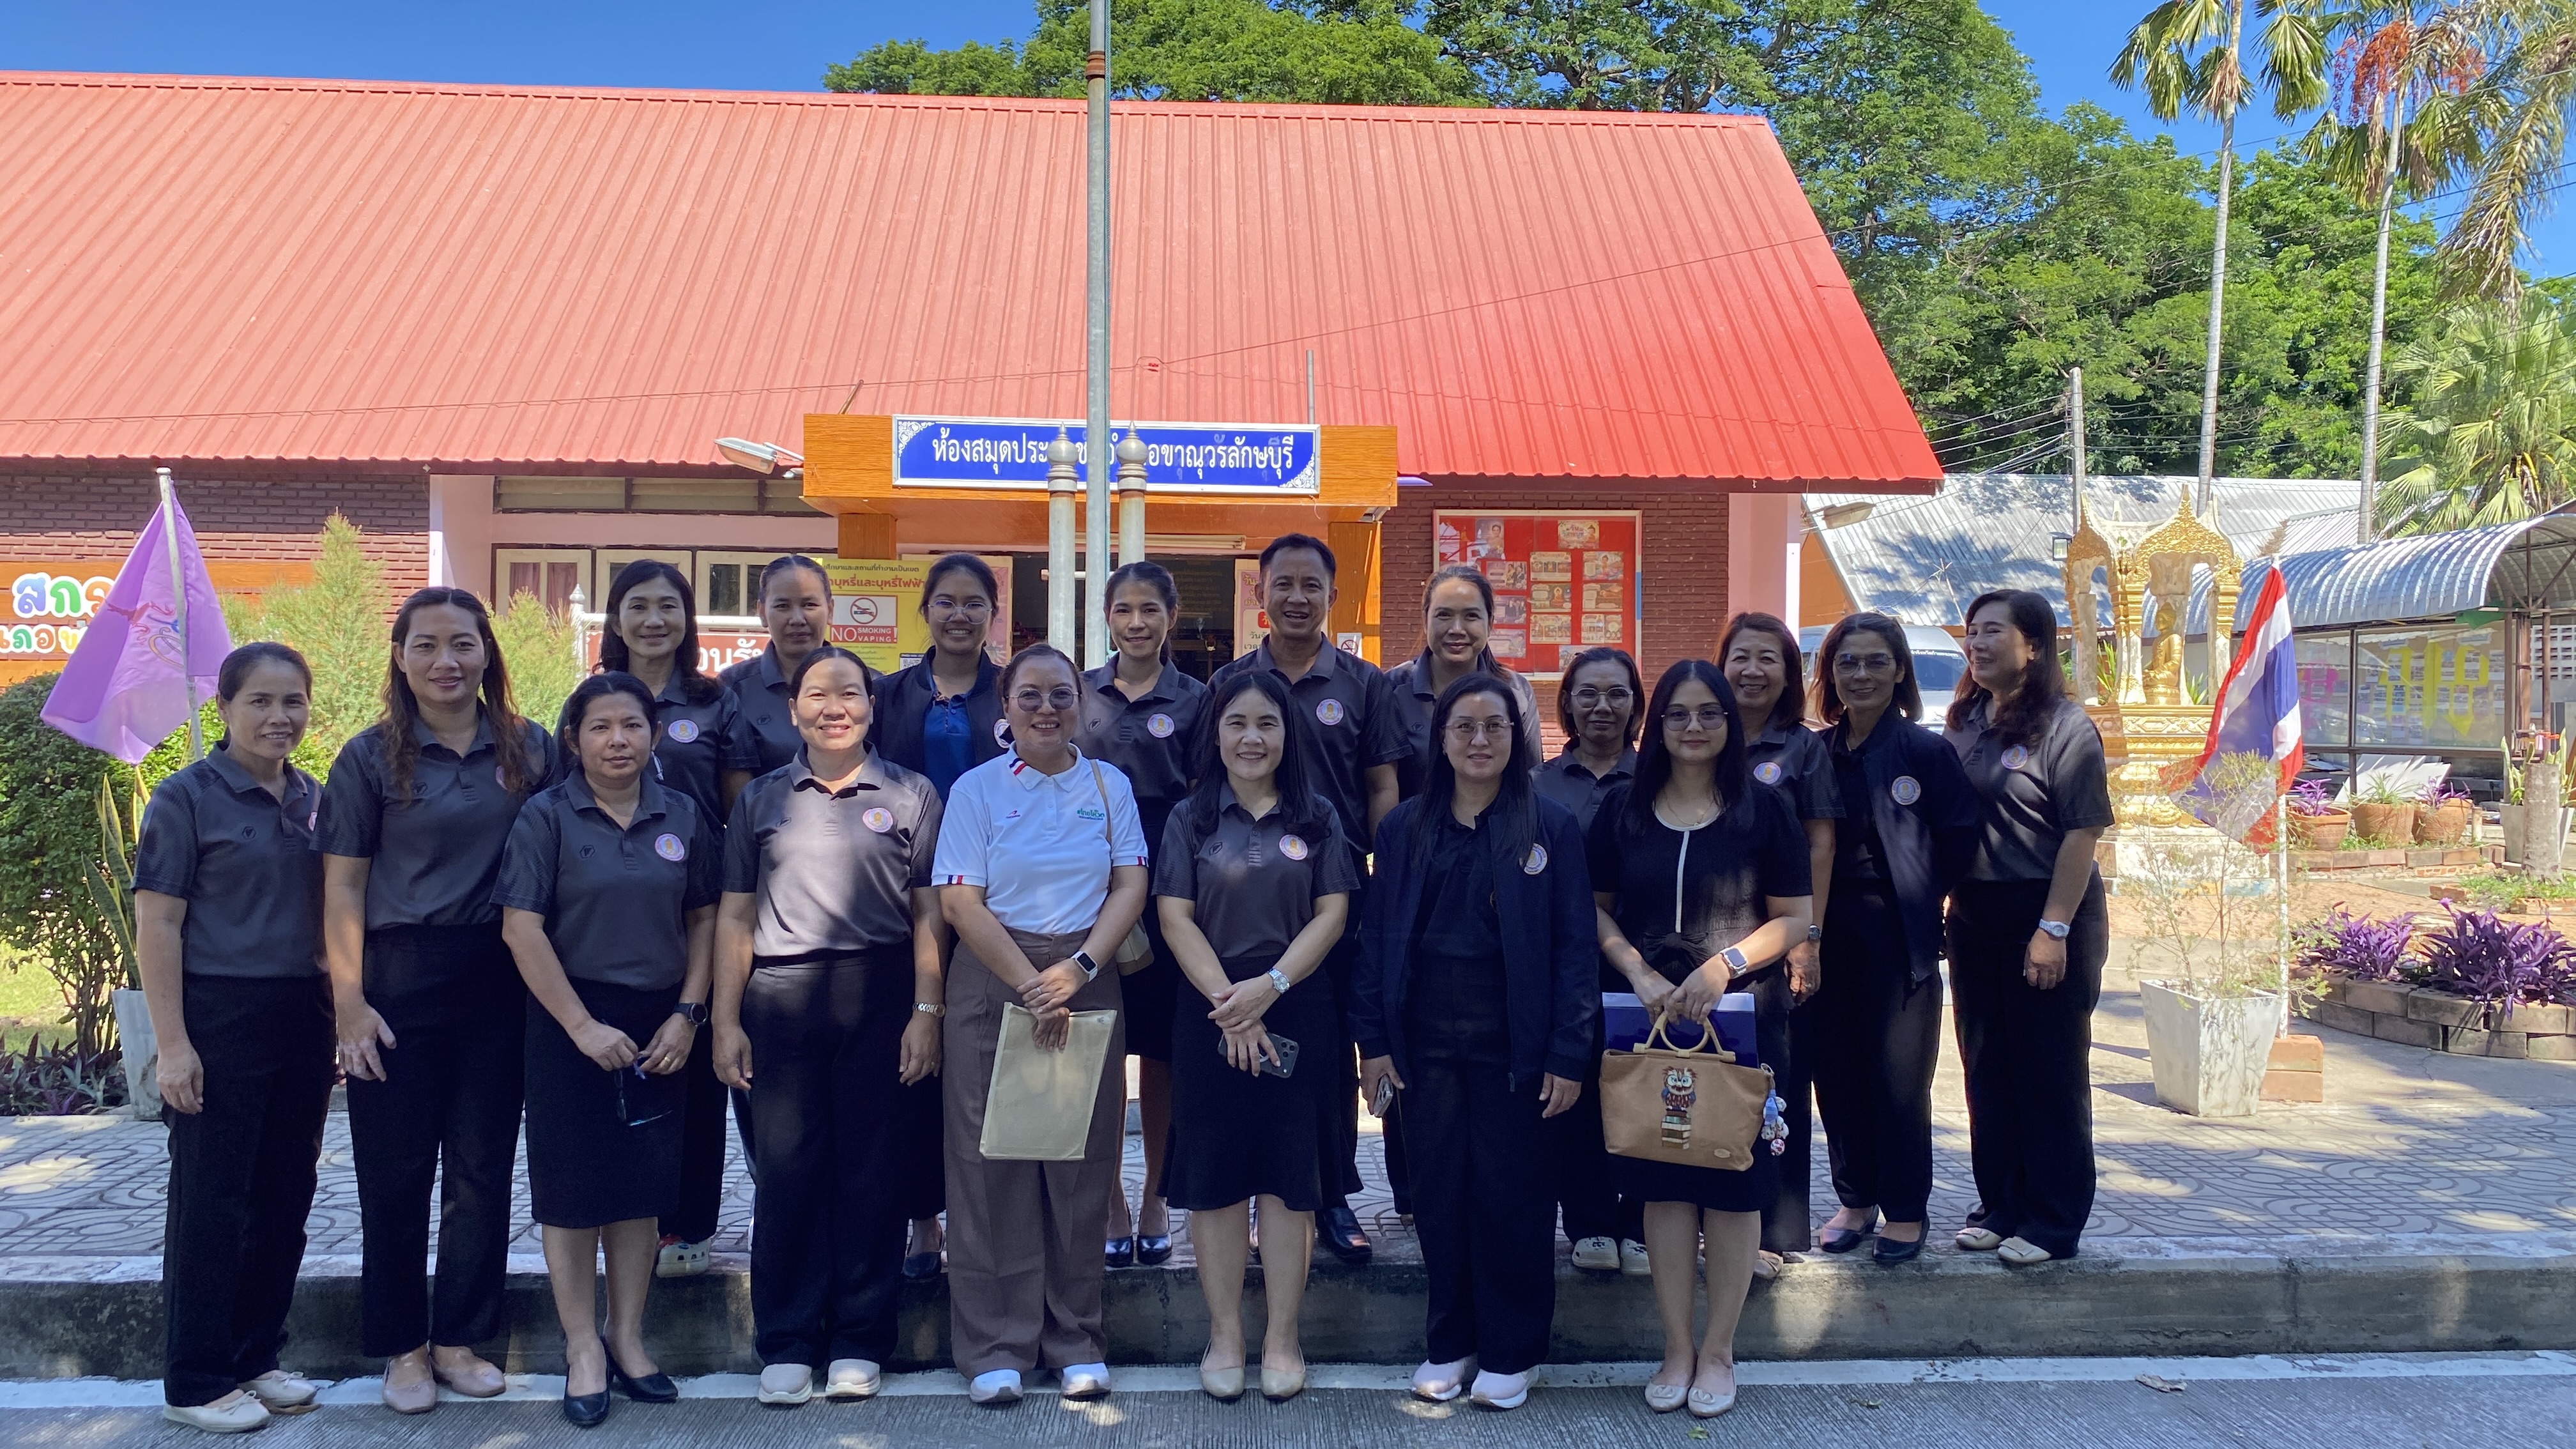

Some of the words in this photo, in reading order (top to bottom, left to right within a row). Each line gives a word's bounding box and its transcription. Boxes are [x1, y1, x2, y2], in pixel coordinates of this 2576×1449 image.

[824, 563, 919, 572] ศึกษาและสถานที่ทำงานเป็นเขต
[831, 627, 857, 642] NO
